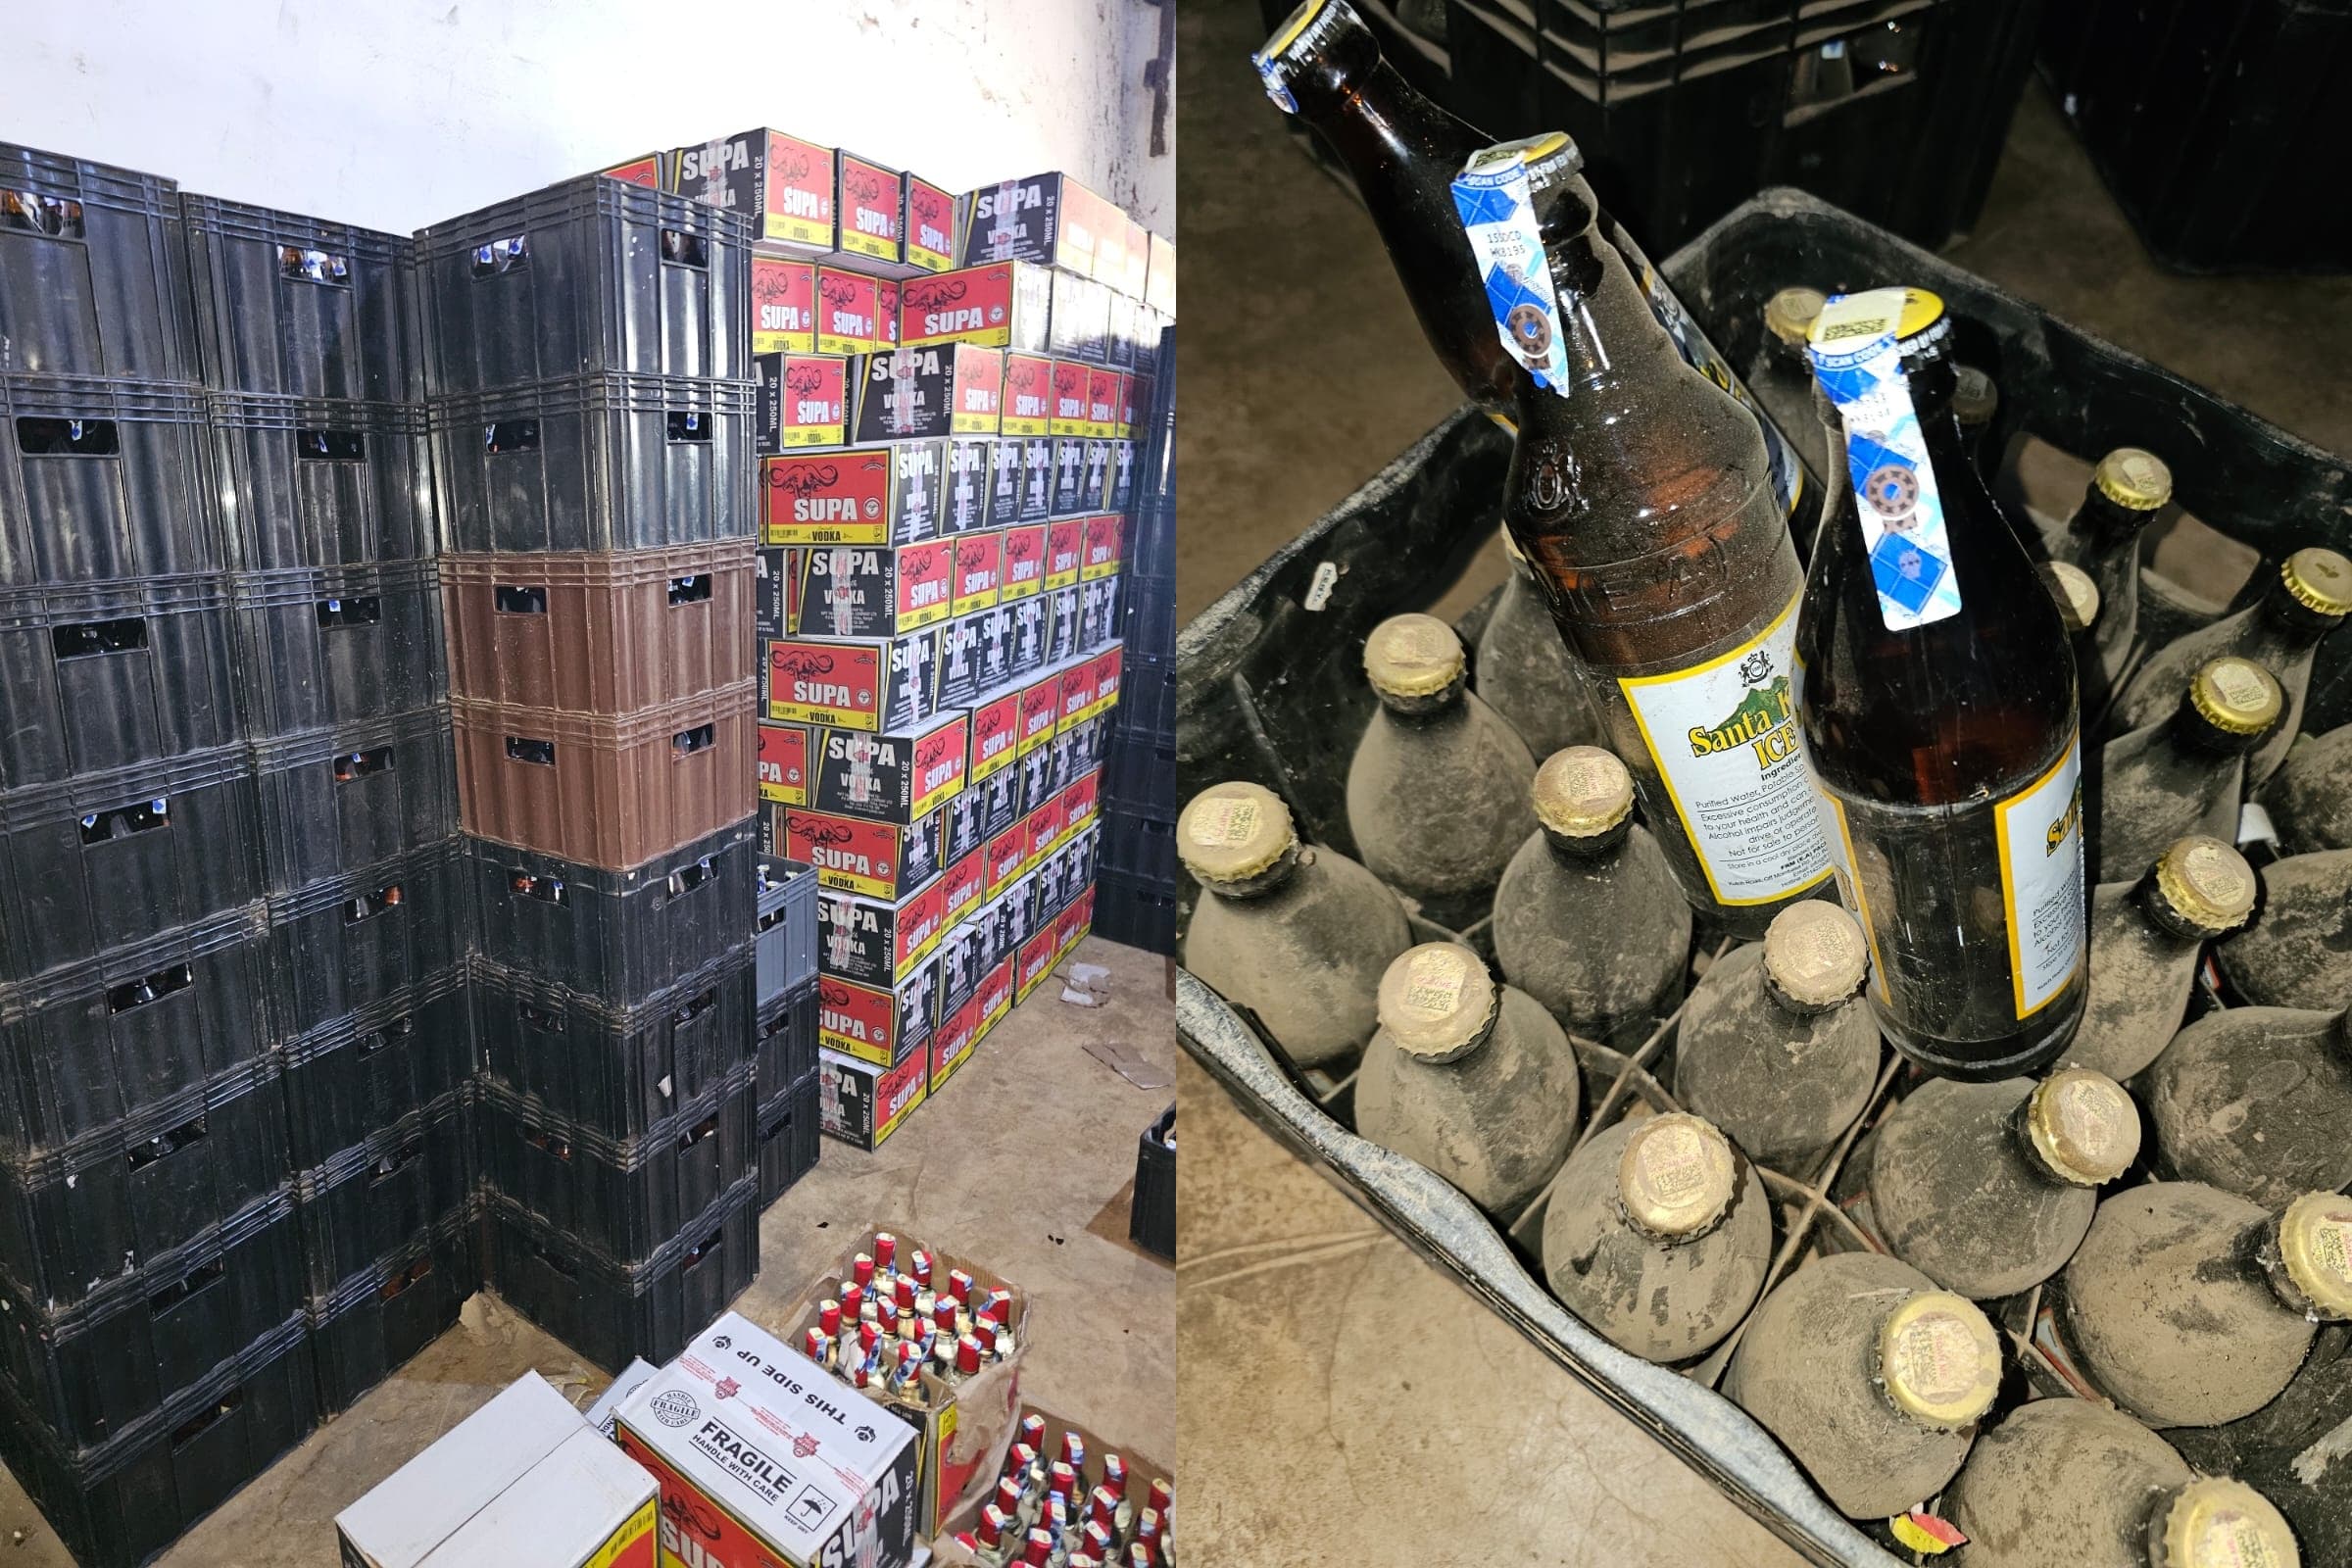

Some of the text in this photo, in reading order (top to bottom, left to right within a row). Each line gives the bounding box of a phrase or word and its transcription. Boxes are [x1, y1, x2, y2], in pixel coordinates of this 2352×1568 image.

[682, 140, 750, 180] SUPA
[783, 186, 818, 220] SUPA
[976, 184, 1042, 219] SUPA
[856, 207, 889, 237] SUPA
[919, 224, 945, 254] SUPA
[760, 305, 800, 330] SUPA
[833, 311, 863, 336] SUPA
[924, 307, 984, 335] SUPA
[871, 350, 940, 382] SUPA
[798, 400, 829, 424] SUPA
[899, 450, 933, 479] SUPA
[794, 498, 858, 521] SUPA
[811, 530, 841, 542] VODKA
[812, 551, 879, 576] SUPA
[910, 579, 938, 609] SUPA
[892, 640, 930, 673] SUPA
[794, 680, 852, 708] SUPA
[809, 711, 836, 724] VODKA
[1027, 713, 1049, 736] SUPA
[982, 736, 1005, 760] SUPA
[1688, 710, 1775, 758] Santa
[1751, 720, 1799, 770] ICE
[828, 736, 897, 767] SUPA
[902, 760, 909, 771] 20
[925, 762, 953, 793] SUPA
[1695, 770, 1794, 808] Purified Water, Potable
[900, 780, 909, 808] 250ML
[1700, 781, 1803, 822] Excessive consumption
[1703, 790, 1808, 832] to your health and can
[1708, 828, 1743, 841] Alcohol
[1744, 819, 1778, 836] impairs
[1729, 848, 1746, 858] Not
[1747, 843, 1761, 855] for
[1762, 837, 1782, 852] sale
[1783, 832, 1792, 843] to
[1748, 831, 1772, 844] drive
[1773, 827, 1783, 836] or
[811, 846, 870, 876] SUPA
[828, 875, 855, 890] VODKA
[817, 901, 879, 933] SUPA
[906, 920, 931, 955] SUPA
[819, 1008, 866, 1041] UPA
[825, 1036, 851, 1053] VODKA
[942, 1031, 966, 1065] SUPA
[889, 1076, 916, 1116] SUPA
[736, 1350, 761, 1367] UP
[761, 1364, 804, 1396] SIDE
[653, 1399, 699, 1417] FRAGILE
[805, 1394, 847, 1425] THIS
[692, 1434, 780, 1502] HANDLE WITH CARE
[700, 1420, 793, 1494] FRAGILE
